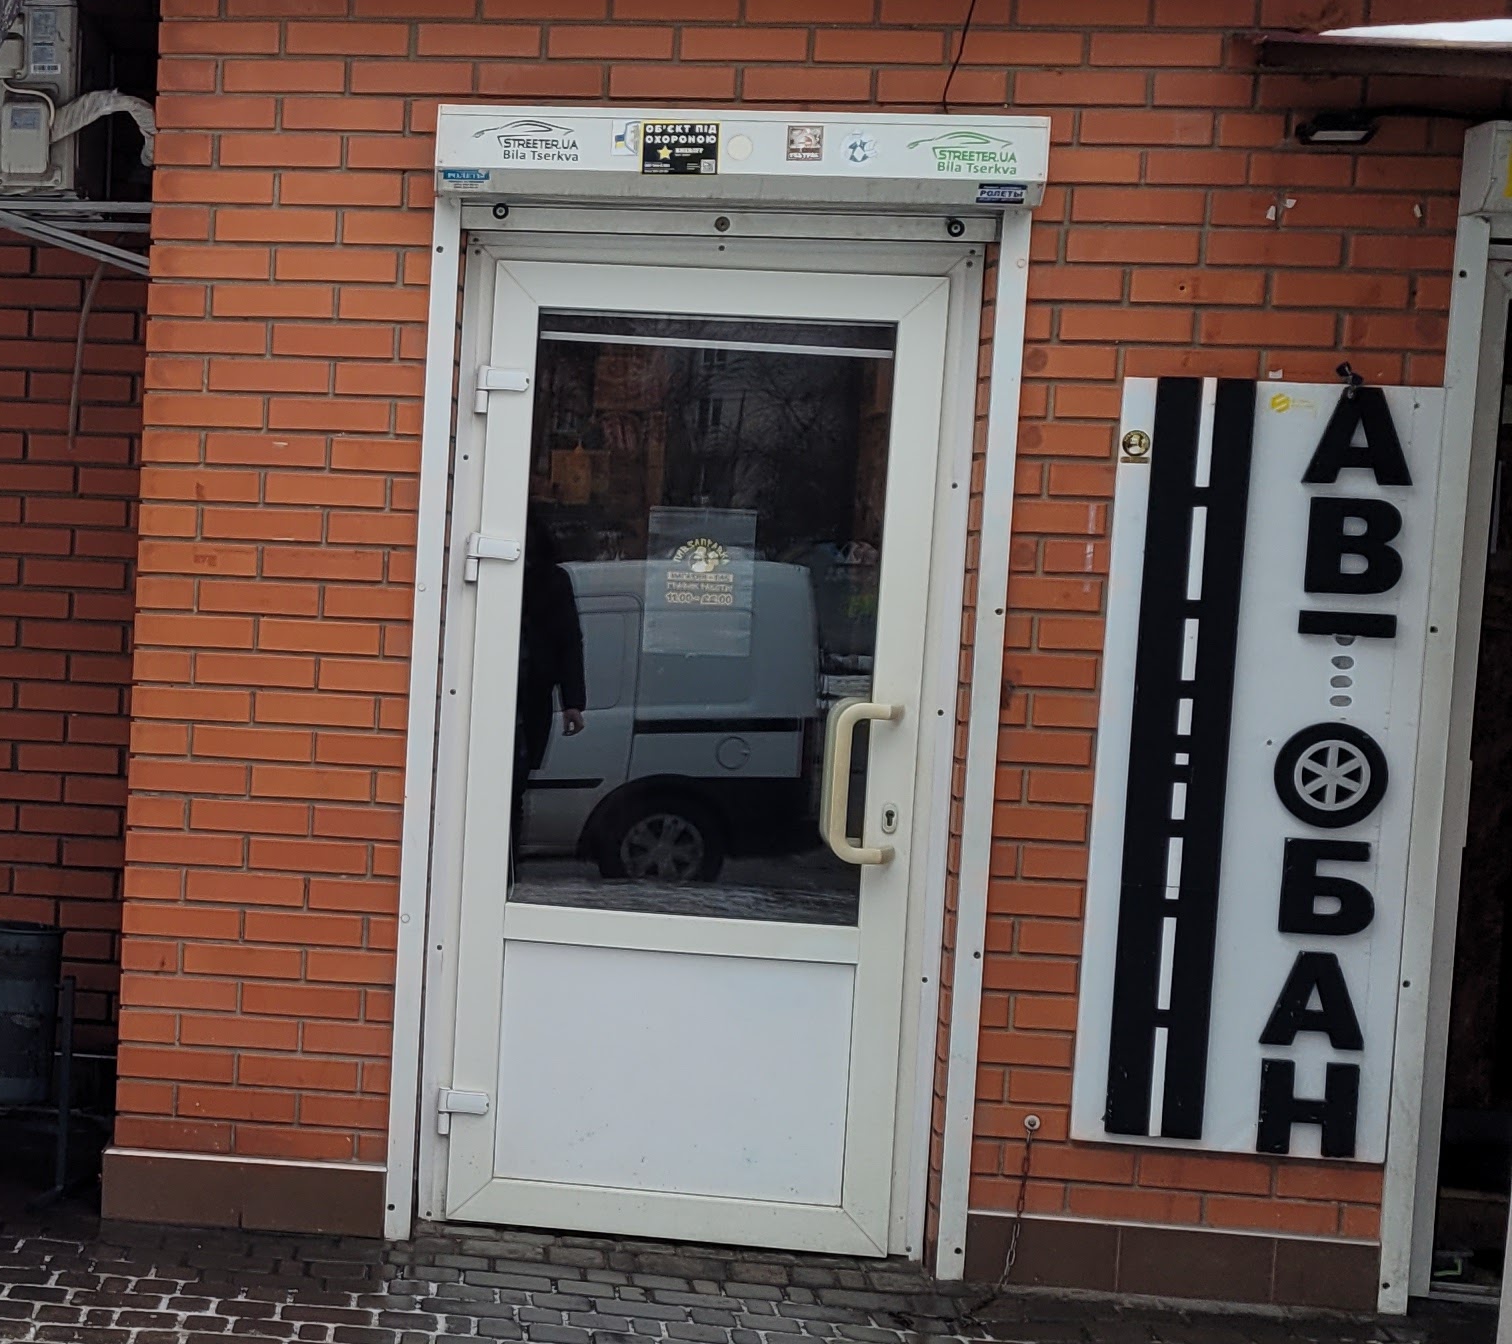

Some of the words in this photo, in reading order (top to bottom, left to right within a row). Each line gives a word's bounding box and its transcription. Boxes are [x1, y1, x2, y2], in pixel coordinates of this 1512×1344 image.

[695, 124, 717, 134] ПІД
[503, 138, 578, 150] STREETER.UA
[503, 150, 526, 160] Bila
[530, 150, 579, 162] Tserkva
[938, 150, 1017, 163] STREETER.UA
[937, 161, 961, 173] Bila
[966, 163, 1017, 175] Tserkva
